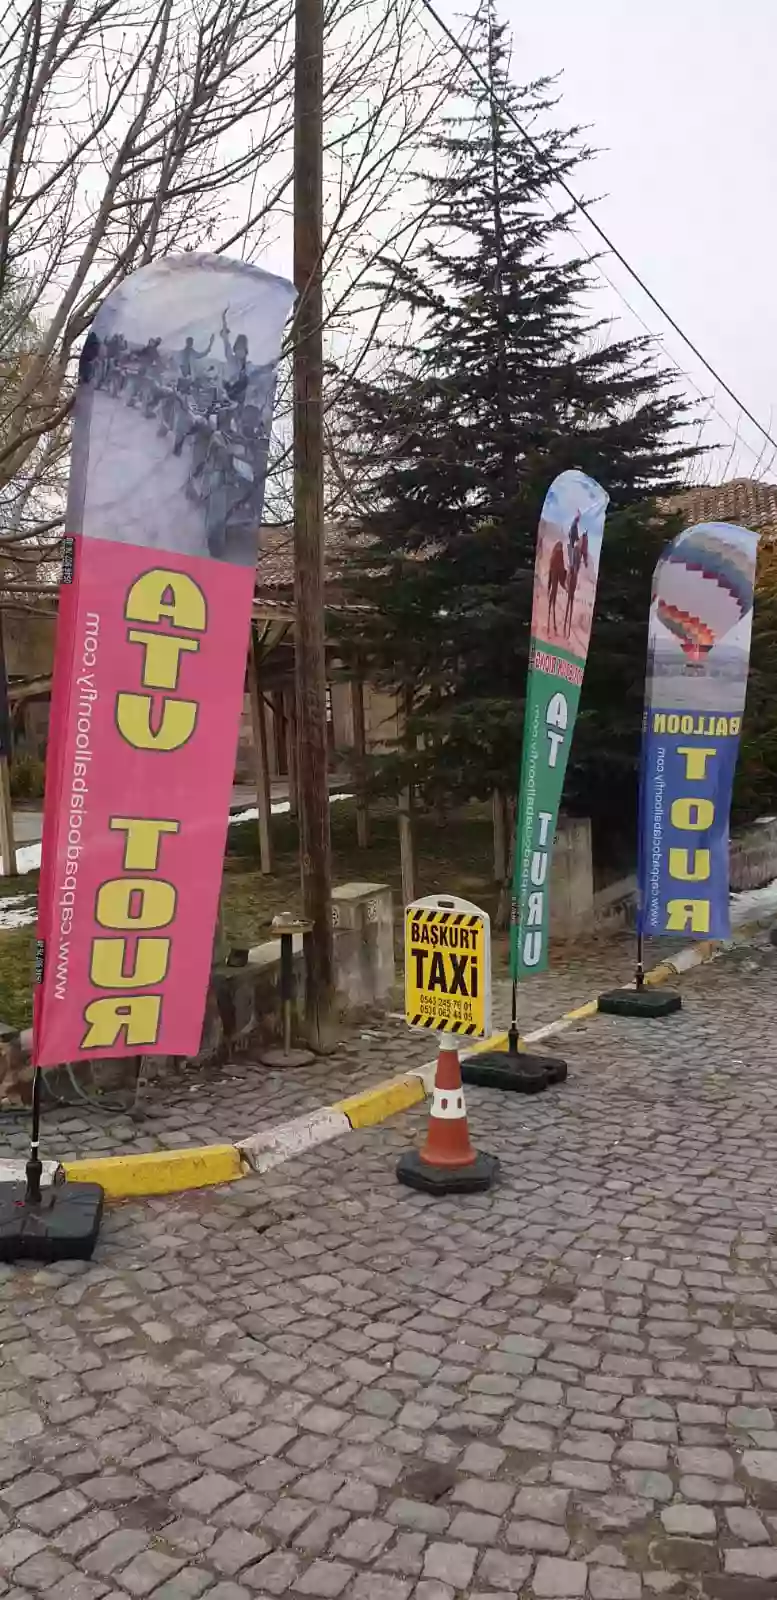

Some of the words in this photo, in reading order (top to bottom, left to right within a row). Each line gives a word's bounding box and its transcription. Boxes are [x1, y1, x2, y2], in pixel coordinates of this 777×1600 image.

[411, 922, 478, 950] BAŞKURT
[464, 1001, 471, 1011] 01
[464, 1012, 472, 1021] 05
